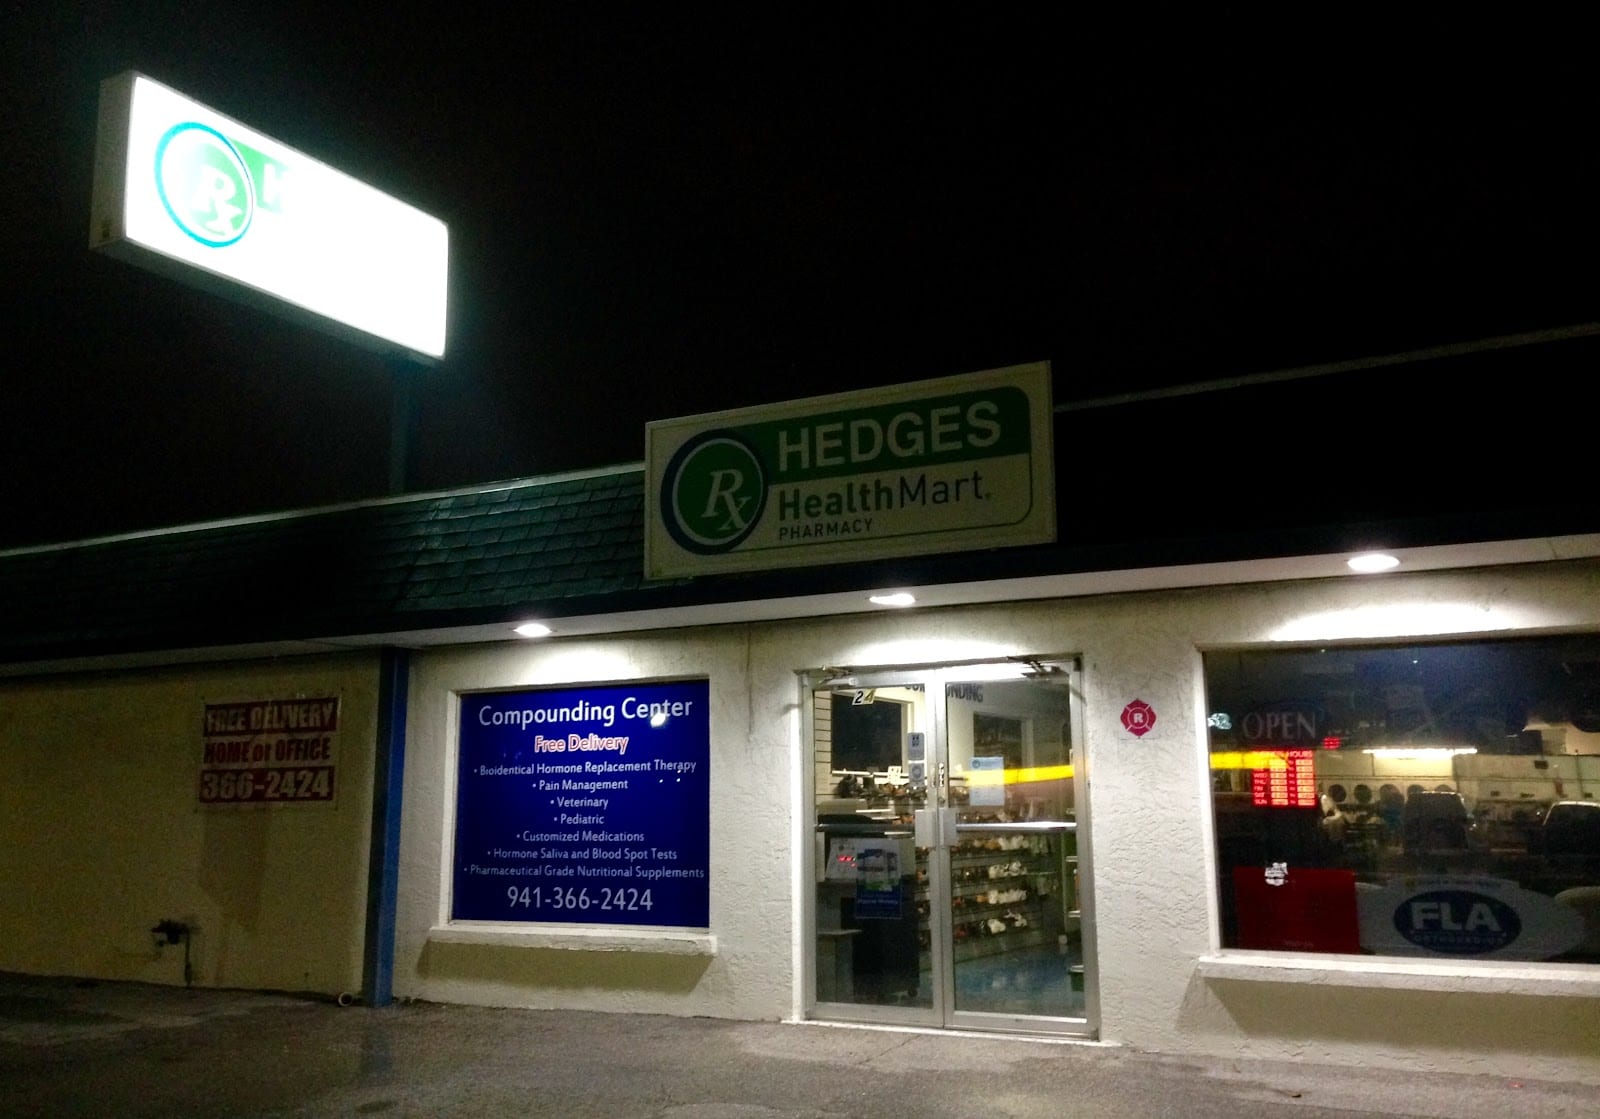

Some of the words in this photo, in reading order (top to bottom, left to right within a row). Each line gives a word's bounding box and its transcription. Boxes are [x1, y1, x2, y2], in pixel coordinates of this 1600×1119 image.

[777, 400, 1002, 473] HEDGES
[778, 517, 874, 541] PHARMACY
[207, 707, 247, 732] FREE
[250, 702, 334, 730] DELIVERY
[478, 700, 615, 731] Compounding
[621, 697, 693, 719] Center
[1241, 710, 1316, 740] OPEN
[204, 741, 250, 764] HOME
[275, 737, 331, 761] OFFICE
[534, 735, 567, 753] Free
[567, 733, 630, 755] Delivery
[480, 764, 535, 776] Bioidentical
[536, 762, 583, 775] Hormone
[584, 761, 651, 775] Replacement
[654, 759, 697, 774] Therapy
[203, 769, 331, 799] 366-2424
[539, 780, 560, 791] Pain
[561, 780, 629, 793] Management
[556, 796, 609, 810] Veterinary
[560, 813, 605, 825] Pediatric
[522, 830, 580, 842] Customized
[581, 830, 645, 842] Medications
[493, 848, 538, 859] Hormone
[540, 848, 569, 860] Saliva
[571, 848, 590, 860] and
[592, 848, 621, 860] Blood
[623, 849, 648, 862] Spot
[651, 848, 678, 860] Tests
[470, 864, 542, 876] Pharmaceutical
[544, 865, 575, 877] Grade
[577, 865, 633, 878] Nutritional
[635, 866, 705, 880] Supplements
[506, 885, 653, 912] 941-366-2424
[1410, 900, 1503, 932] FLA
